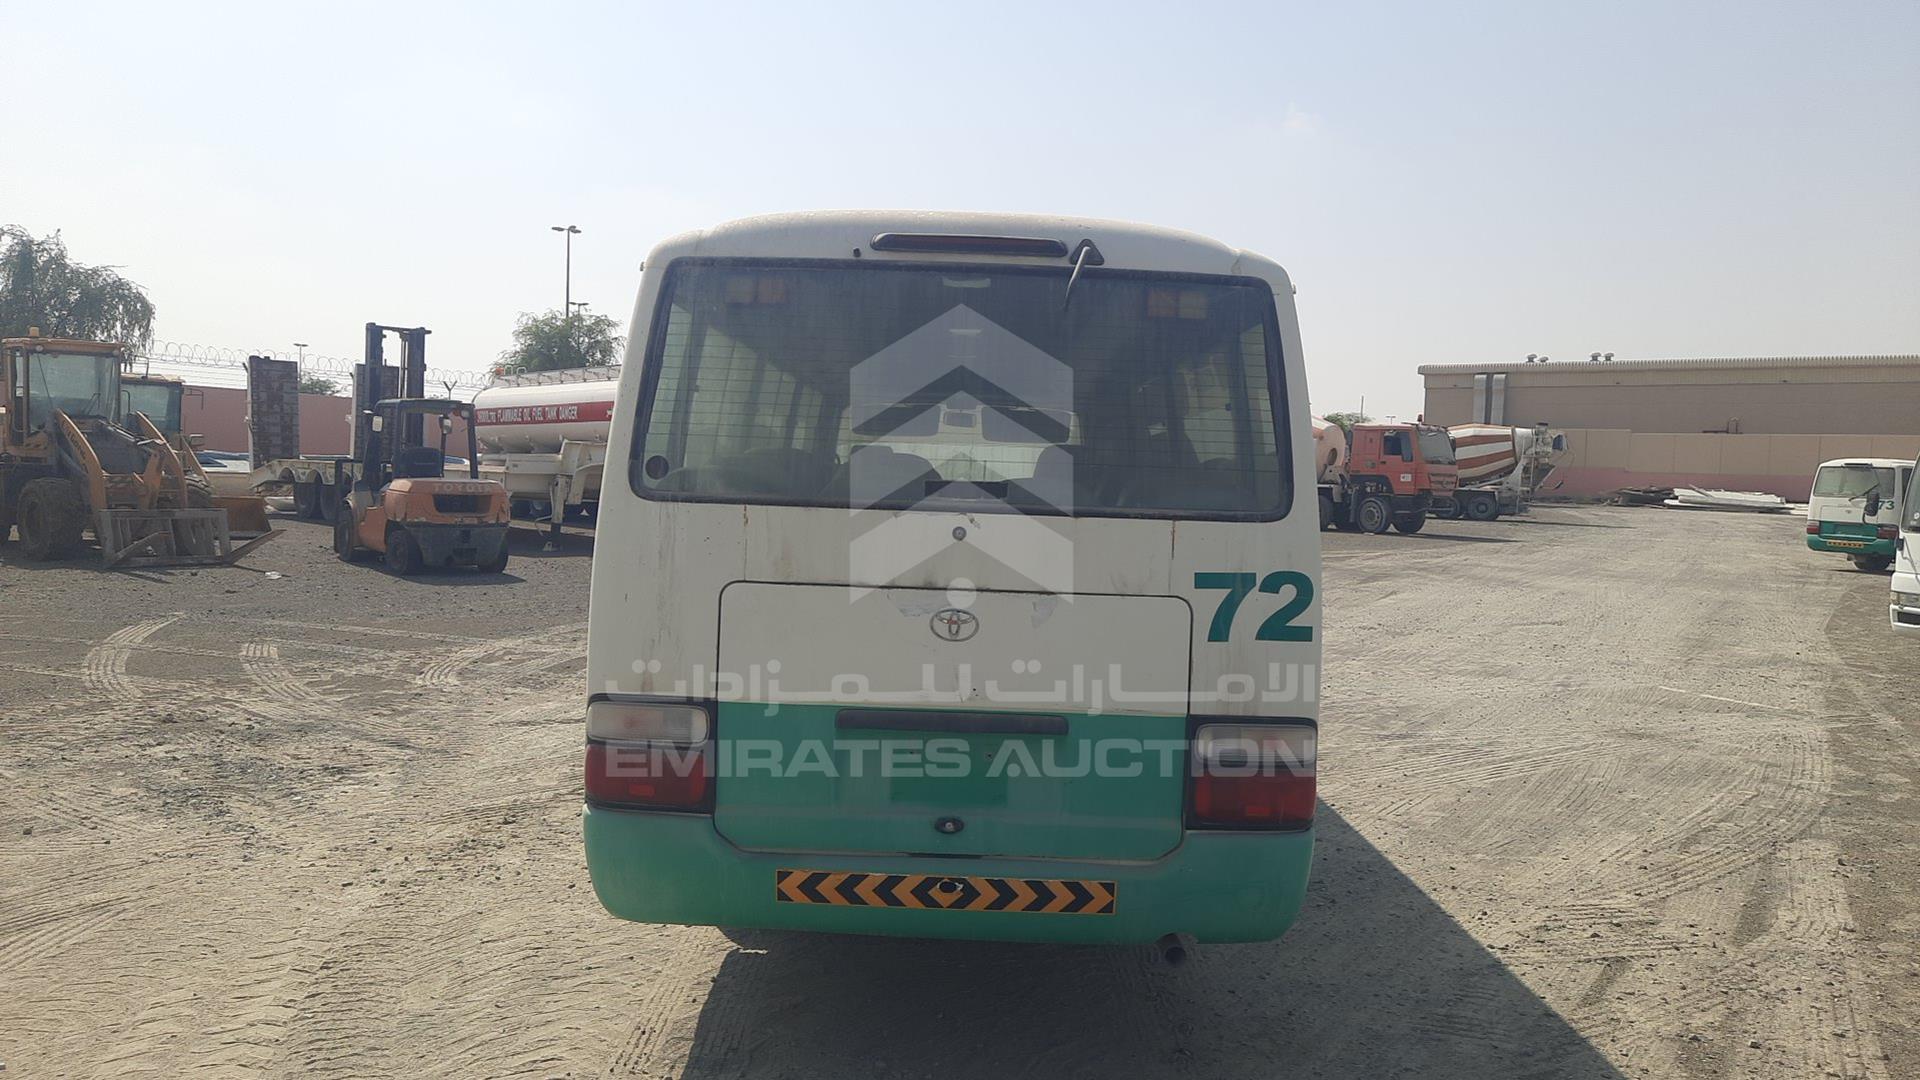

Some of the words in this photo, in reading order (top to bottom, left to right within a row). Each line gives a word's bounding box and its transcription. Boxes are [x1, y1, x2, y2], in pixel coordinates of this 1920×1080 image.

[559, 405, 578, 420] DANGER
[432, 482, 494, 492] TOYOTA
[1879, 500, 1895, 511] 73
[1194, 571, 1314, 642] 72
